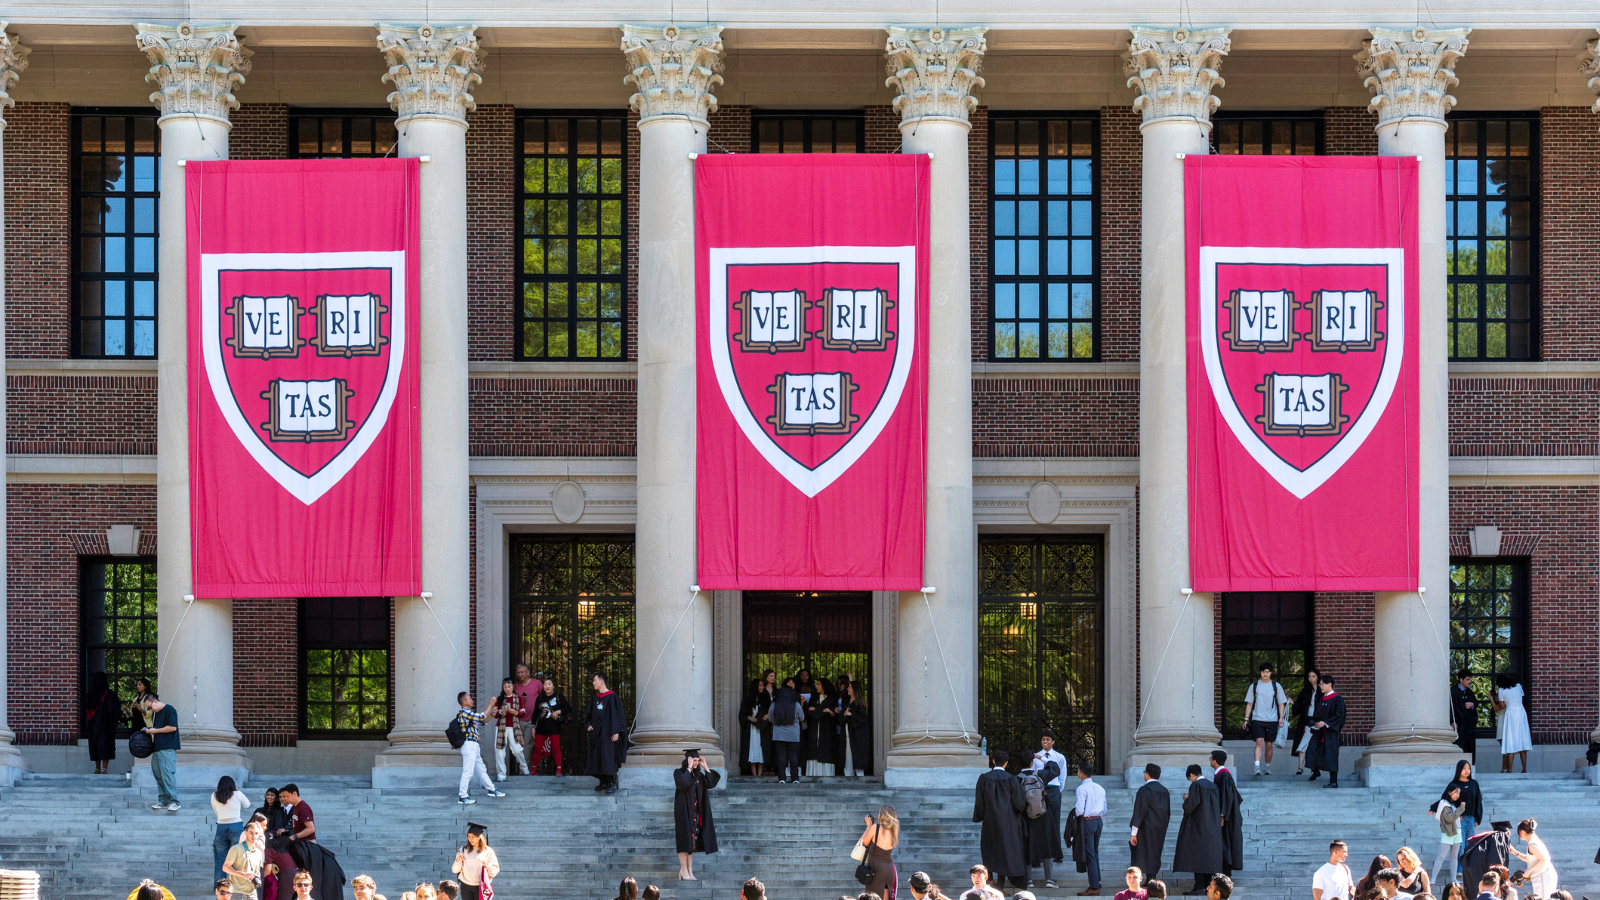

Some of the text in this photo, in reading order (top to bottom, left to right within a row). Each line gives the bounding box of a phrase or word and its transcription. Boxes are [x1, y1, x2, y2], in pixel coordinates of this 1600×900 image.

[245, 310, 361, 336] VE RI
[753, 304, 867, 330] VE RI
[1242, 306, 1357, 330] VE RI
[285, 393, 331, 418] TAS
[791, 387, 835, 411] TAS
[1279, 387, 1325, 412] TAS
